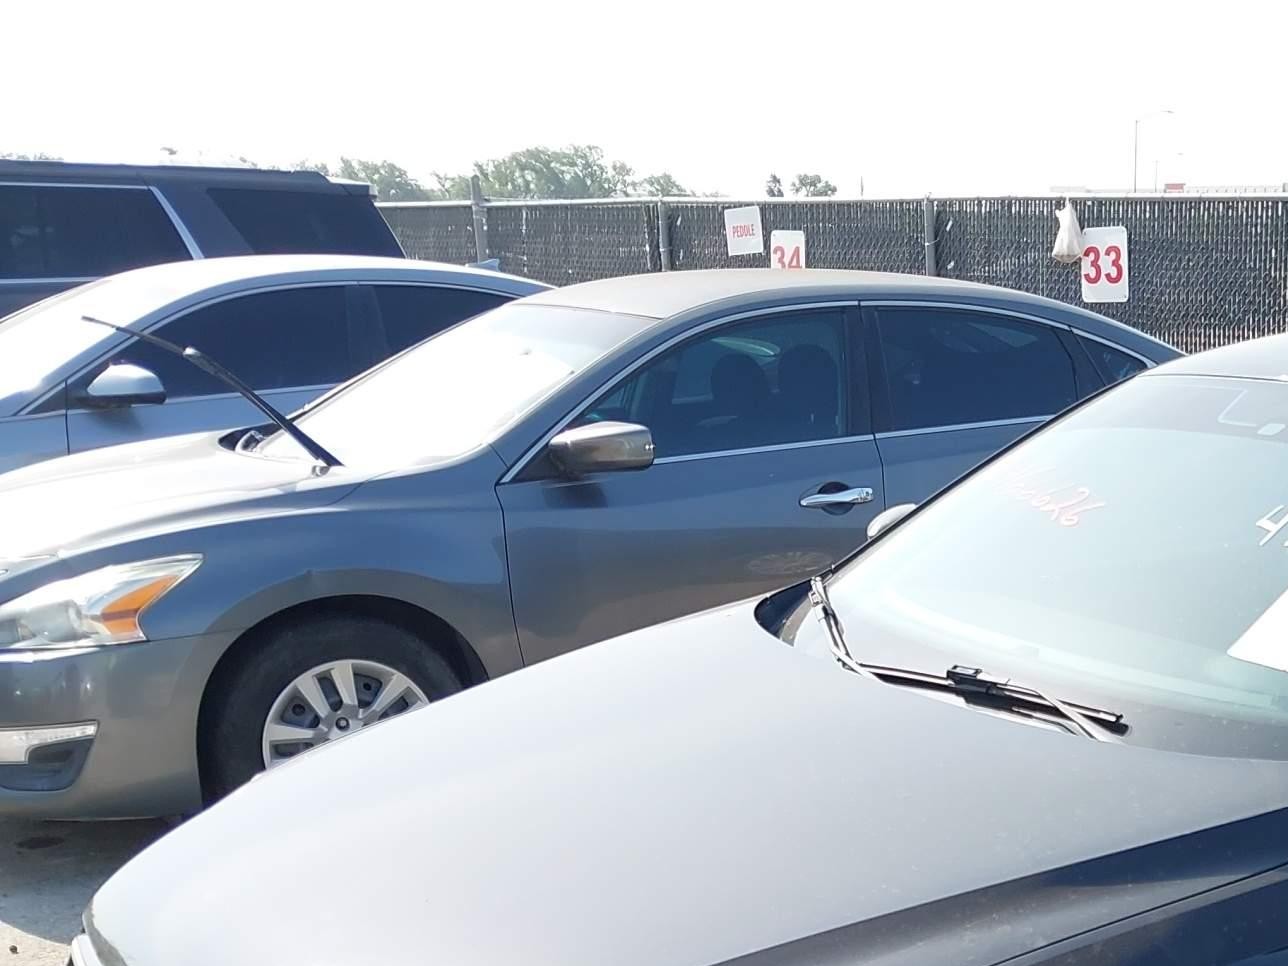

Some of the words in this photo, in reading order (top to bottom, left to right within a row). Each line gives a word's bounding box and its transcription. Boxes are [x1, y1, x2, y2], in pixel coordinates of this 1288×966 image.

[732, 223, 755, 239] PEDDLE
[772, 245, 803, 268] 34
[1083, 245, 1124, 285] 33
